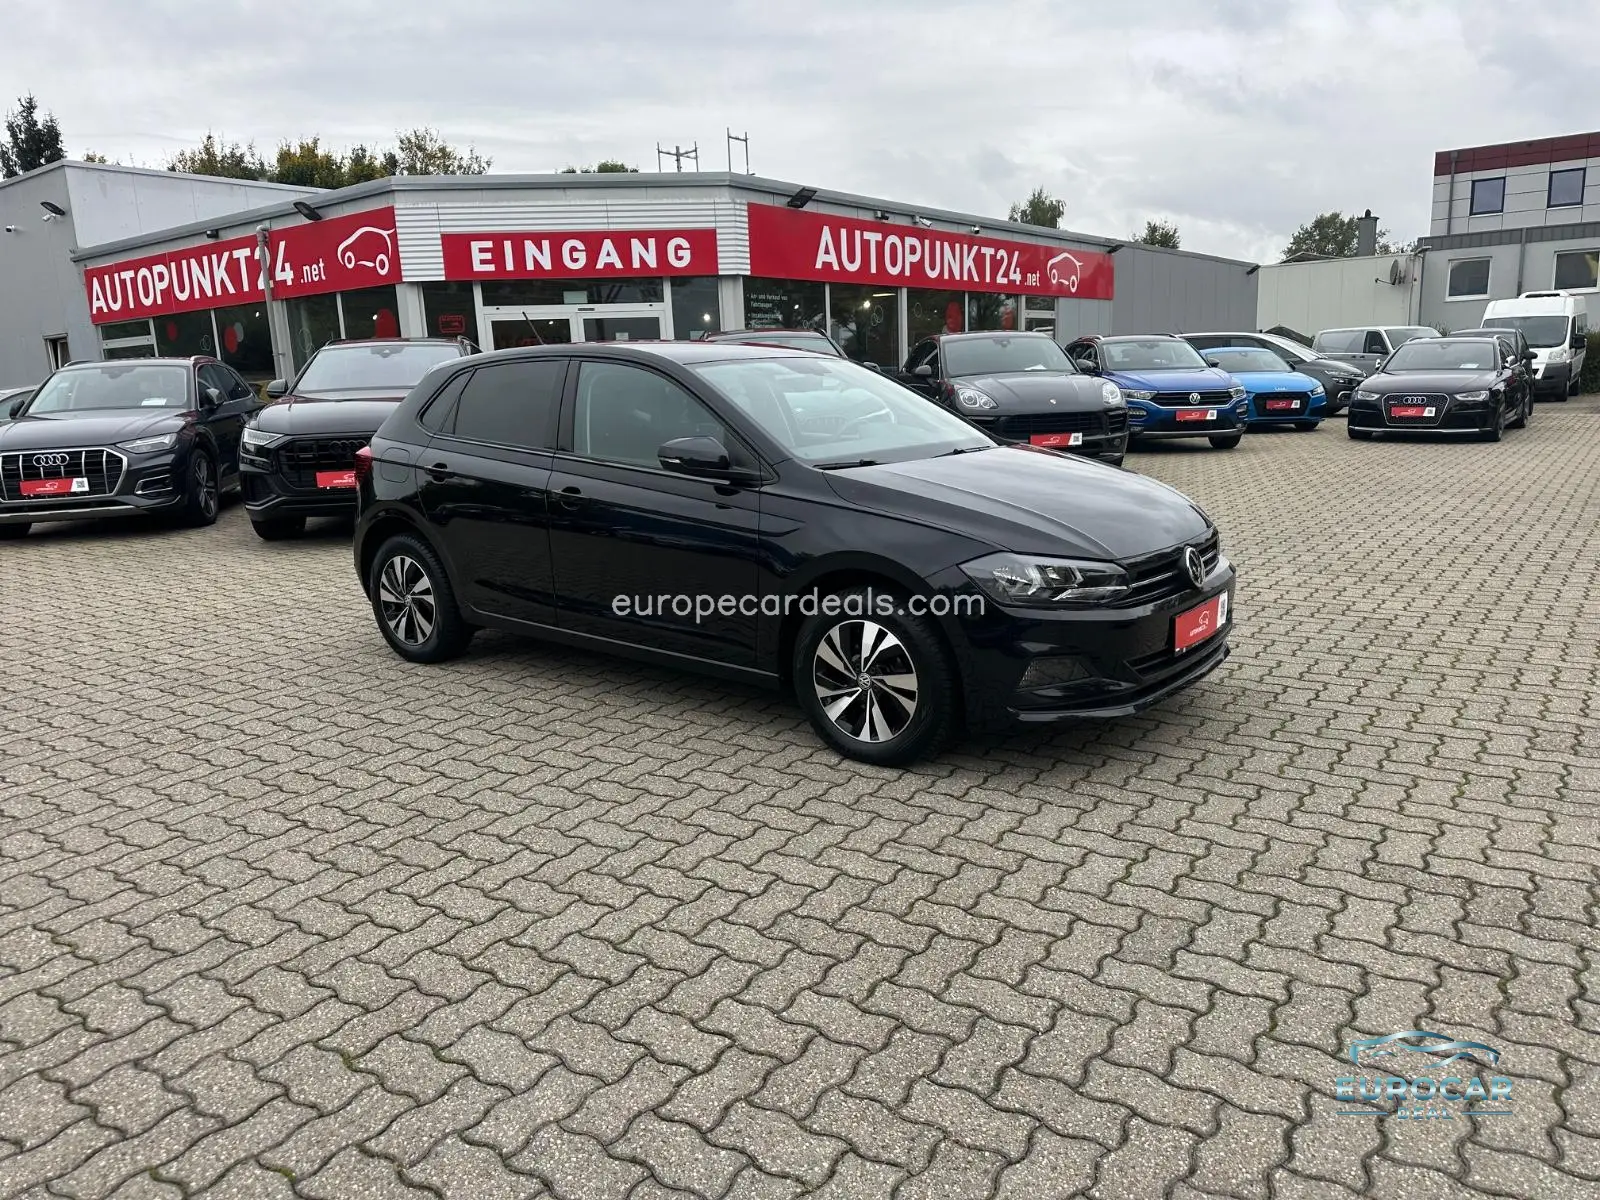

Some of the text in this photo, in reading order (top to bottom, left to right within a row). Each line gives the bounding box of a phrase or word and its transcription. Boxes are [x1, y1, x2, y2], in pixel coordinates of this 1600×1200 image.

[92, 240, 327, 315] AUTOPUNKT24 .net
[470, 237, 691, 272] EINGANG
[815, 225, 1041, 287] AUTOPUNKT24 .net
